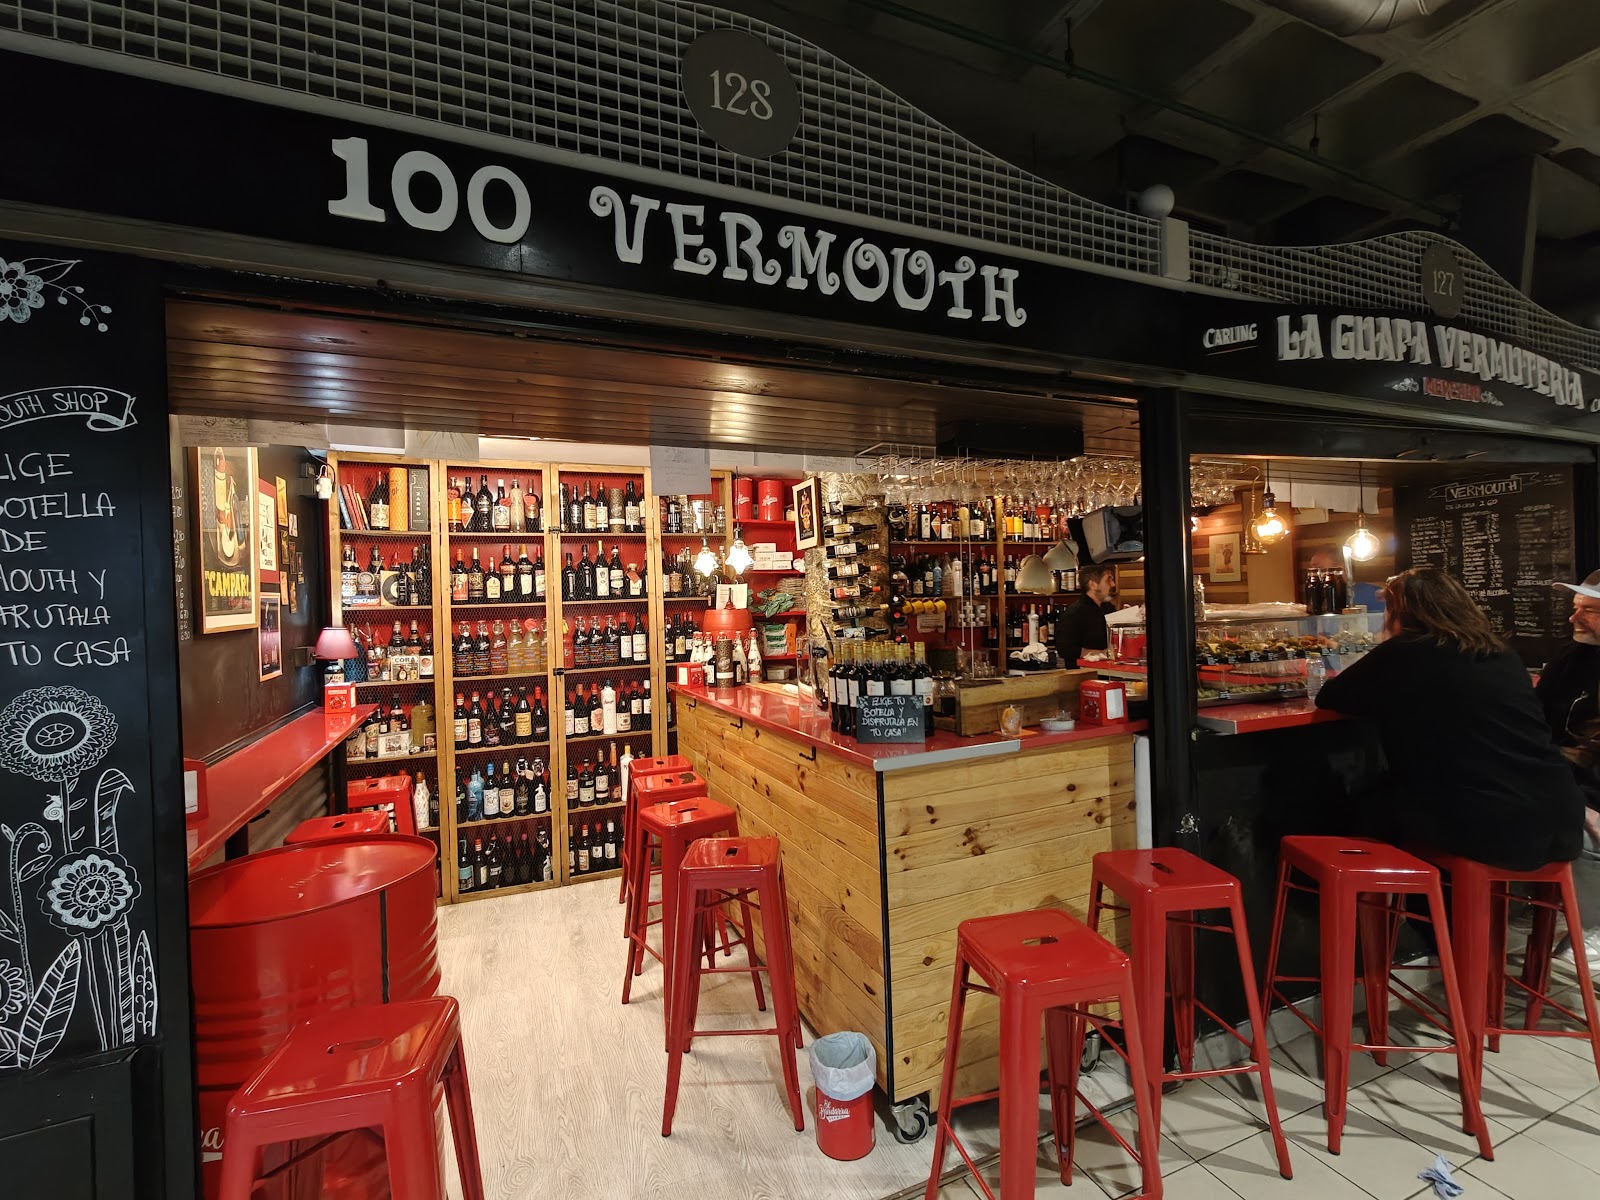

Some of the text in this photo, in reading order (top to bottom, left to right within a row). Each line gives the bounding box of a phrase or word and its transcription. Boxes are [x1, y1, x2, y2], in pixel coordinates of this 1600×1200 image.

[709, 69, 773, 120] 128
[328, 137, 1028, 330] 100 VERMOUTH
[1433, 269, 1454, 296] 127
[1203, 323, 1257, 348] CARLING
[1277, 314, 1324, 361] LA
[1331, 315, 1432, 365] GUAPA
[1434, 325, 1585, 410] VERMUTERIA
[52, 391, 109, 412] SHOP
[1450, 481, 1517, 499] VERMOUTH
[0, 491, 116, 519] OTELLA
[89, 569, 106, 600] Y
[54, 636, 131, 668] CASA
[863, 707, 905, 718] BOTELLA Y
[872, 696, 905, 707] ELIGE TU
[862, 717, 918, 727] DISFRUTALA EN
